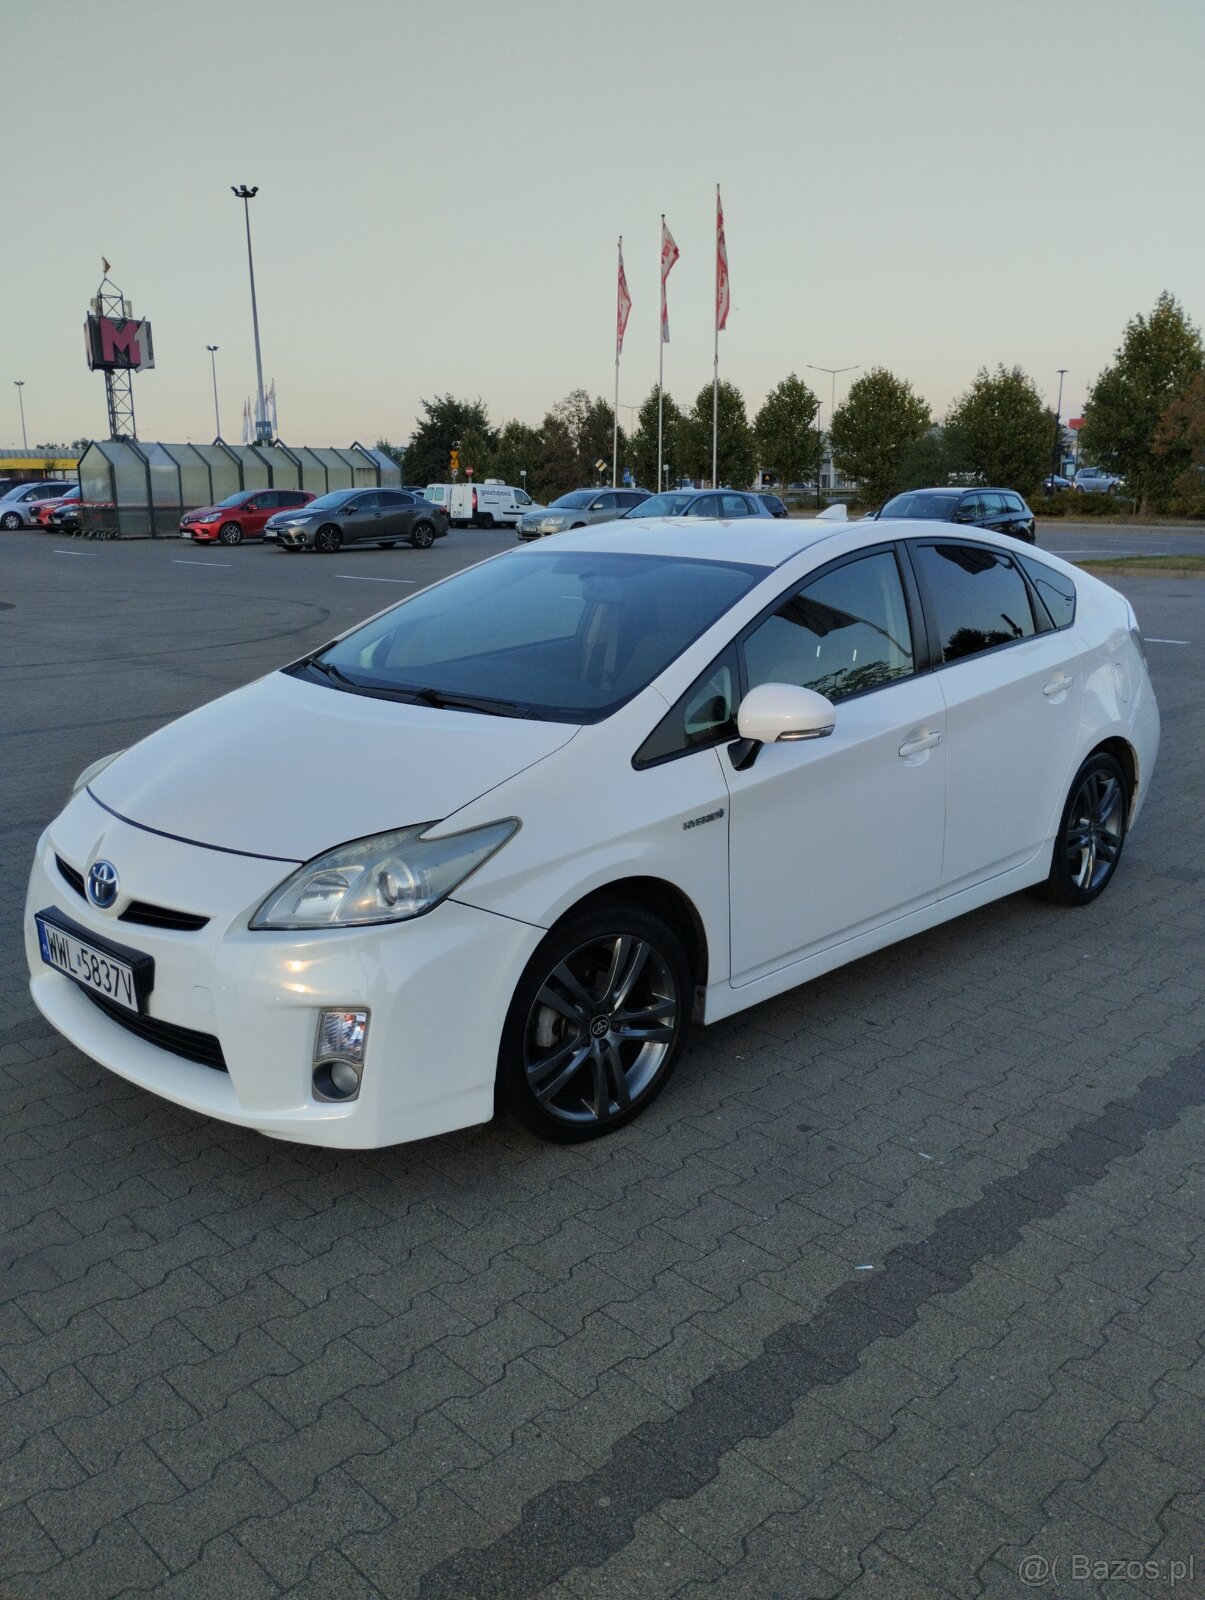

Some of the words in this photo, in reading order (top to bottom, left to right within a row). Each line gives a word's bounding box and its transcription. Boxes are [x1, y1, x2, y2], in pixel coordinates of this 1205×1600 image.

[100, 316, 154, 373] M1
[480, 489, 512, 497] goodspeed
[683, 810, 722, 830] HYBRID
[46, 929, 77, 975] WWL
[80, 947, 132, 1005] 5837V
